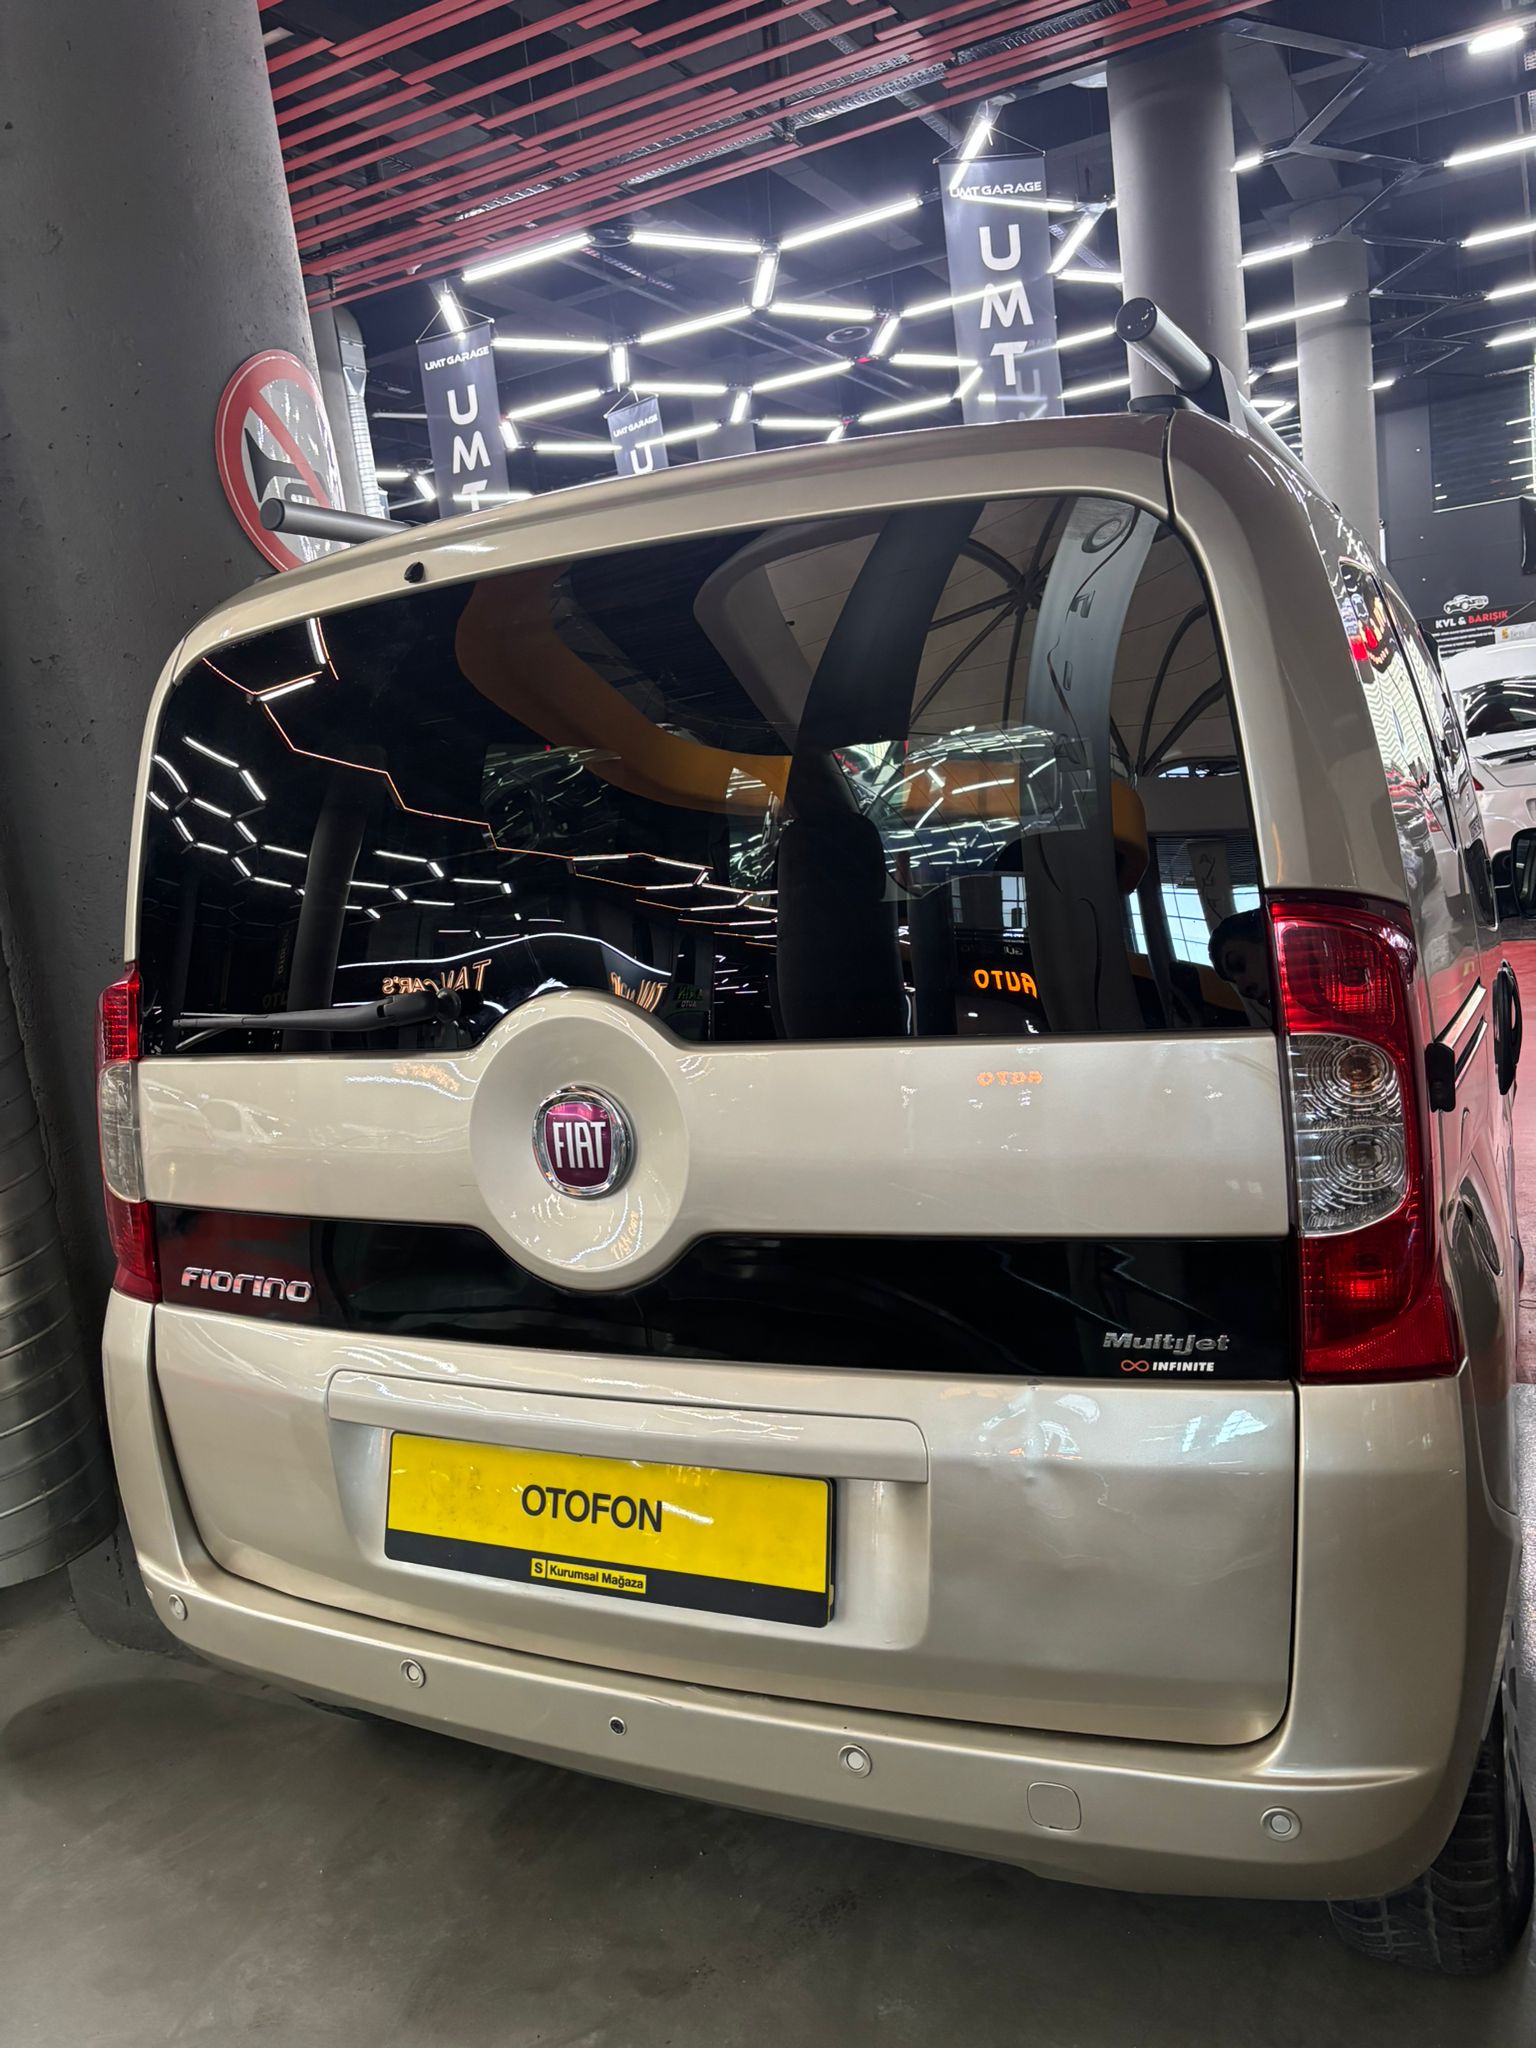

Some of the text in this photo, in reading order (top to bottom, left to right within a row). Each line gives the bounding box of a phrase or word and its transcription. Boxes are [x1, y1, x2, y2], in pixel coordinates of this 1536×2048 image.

[949, 181, 1042, 198] UMT GARAGE
[424, 345, 490, 371] UMT GARAGE
[612, 413, 658, 438] UMT GARAGE
[1435, 618, 1457, 629] KVL
[1457, 616, 1467, 625] &
[552, 1121, 606, 1169] FIAT
[1152, 1361, 1215, 1372] INFINITE
[521, 1484, 663, 1533] OTOFON
[534, 1562, 644, 1589] S Kurumsal Mağaza
